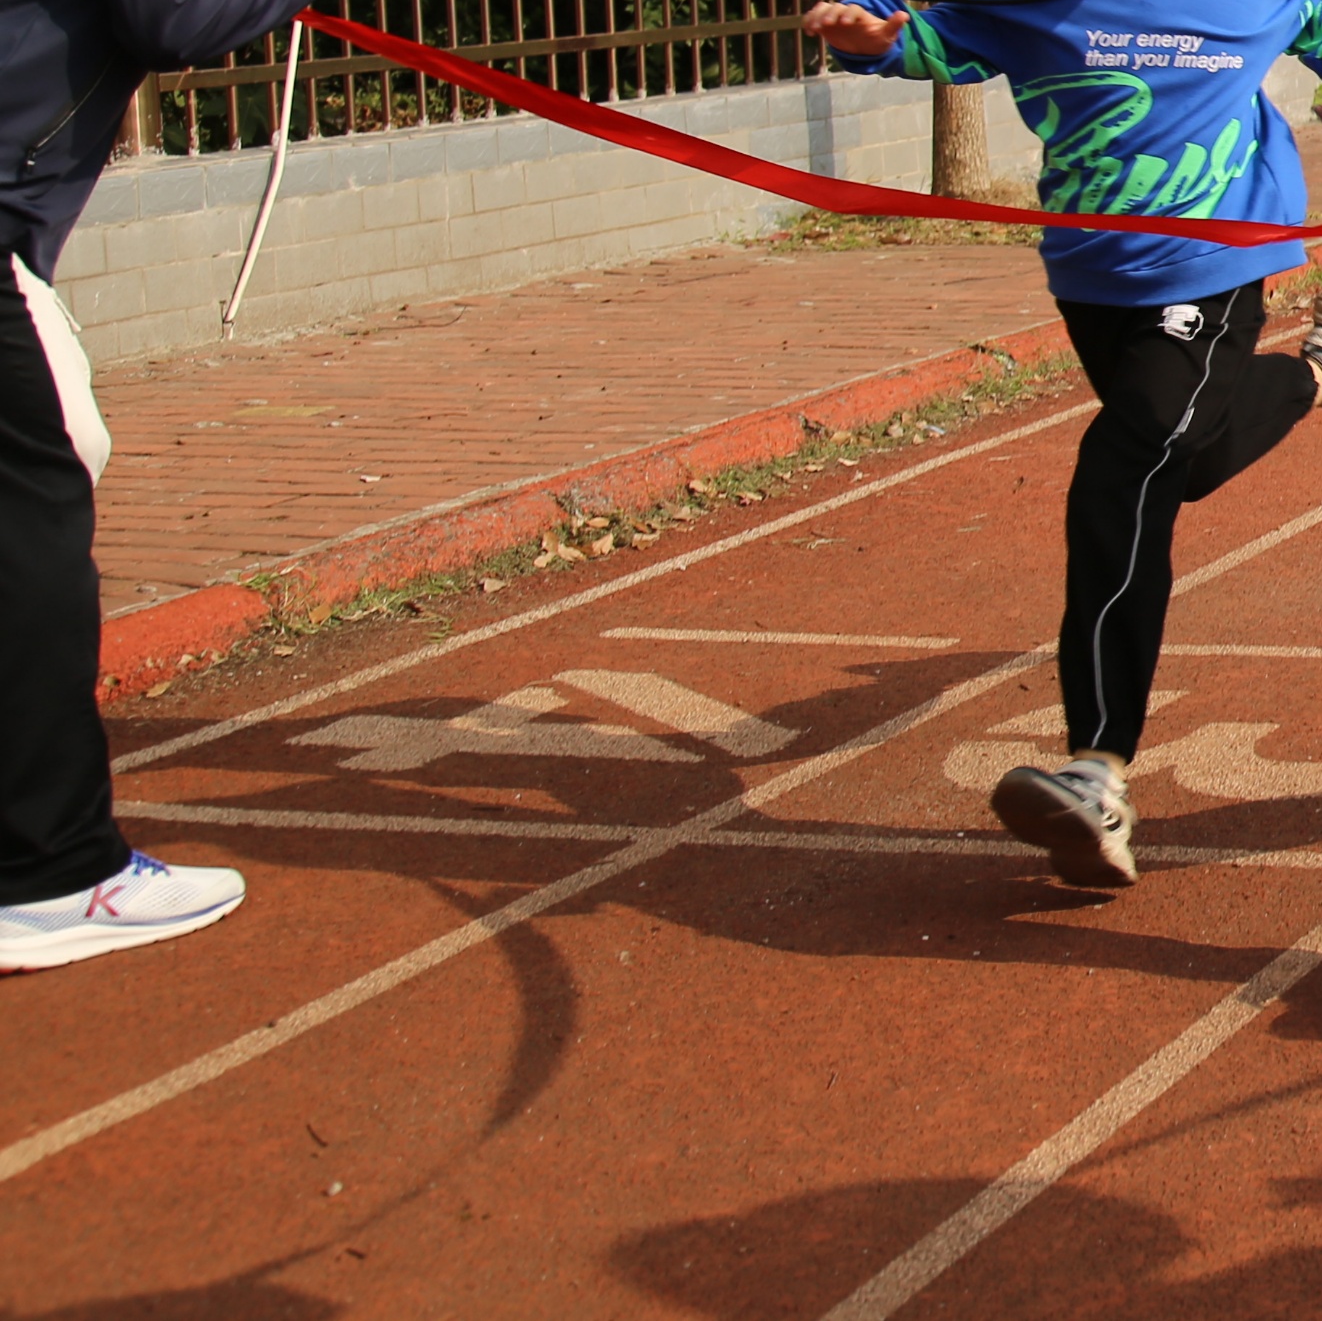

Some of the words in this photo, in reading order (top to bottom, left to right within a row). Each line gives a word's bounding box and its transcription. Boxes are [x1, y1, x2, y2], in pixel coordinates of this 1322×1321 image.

[1085, 29, 1134, 48] Your
[1136, 33, 1205, 53] energy
[1084, 49, 1129, 67] than
[1131, 52, 1170, 71] you
[1173, 51, 1244, 73] imagine
